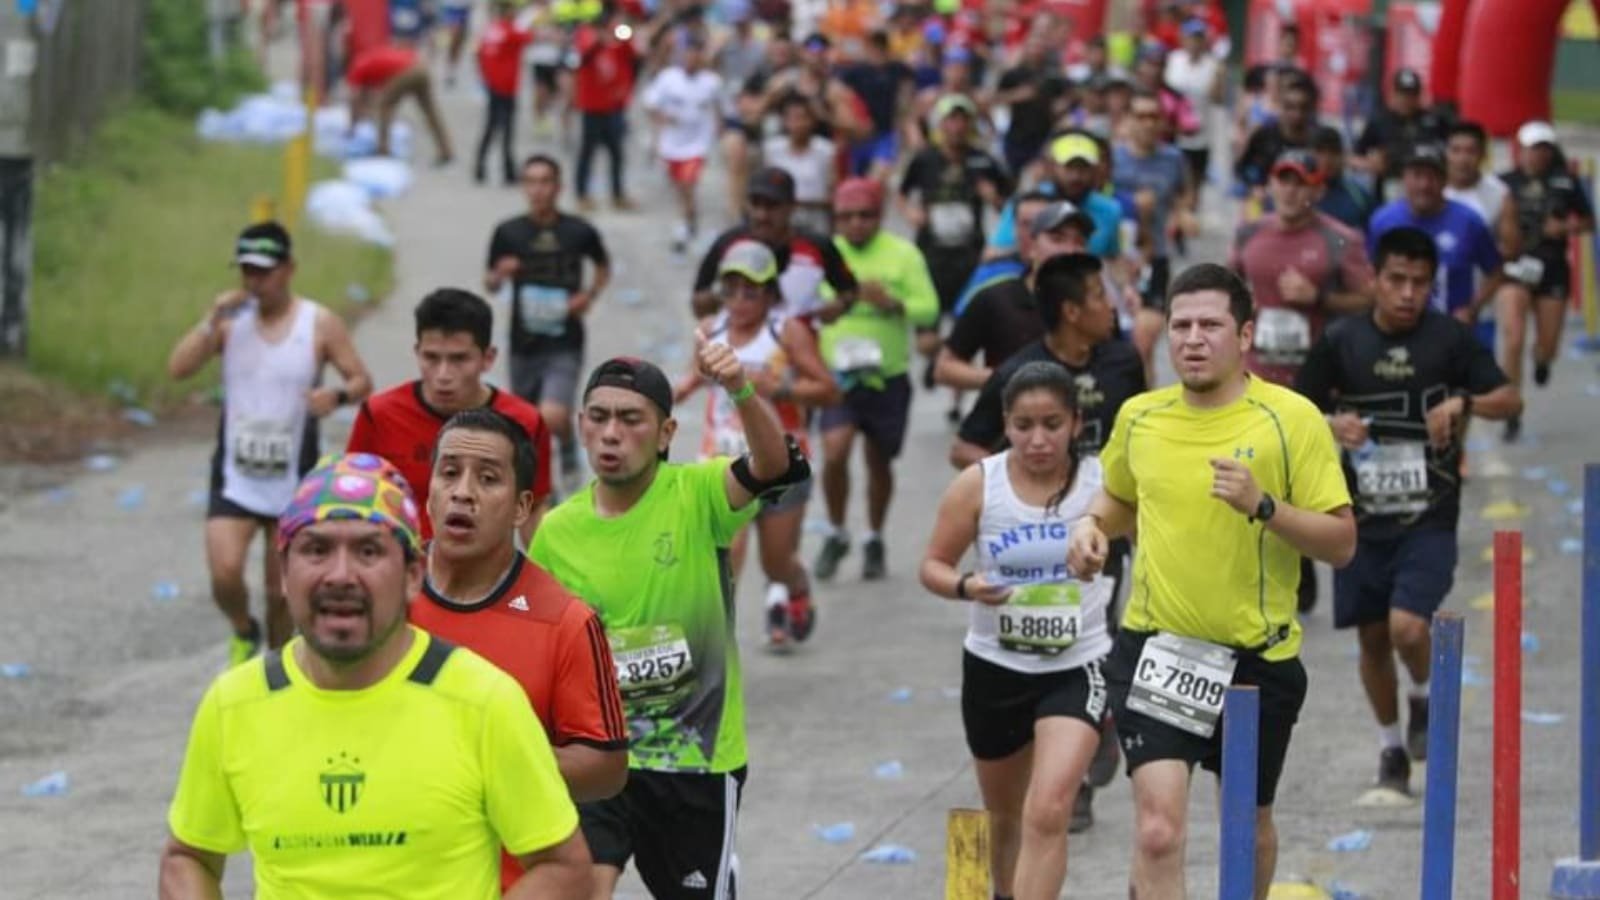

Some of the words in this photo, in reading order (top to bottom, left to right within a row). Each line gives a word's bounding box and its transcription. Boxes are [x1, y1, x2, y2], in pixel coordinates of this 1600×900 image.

[999, 614, 1077, 639] D-8884
[615, 651, 687, 686] -8257
[1138, 658, 1224, 706] C-7809
